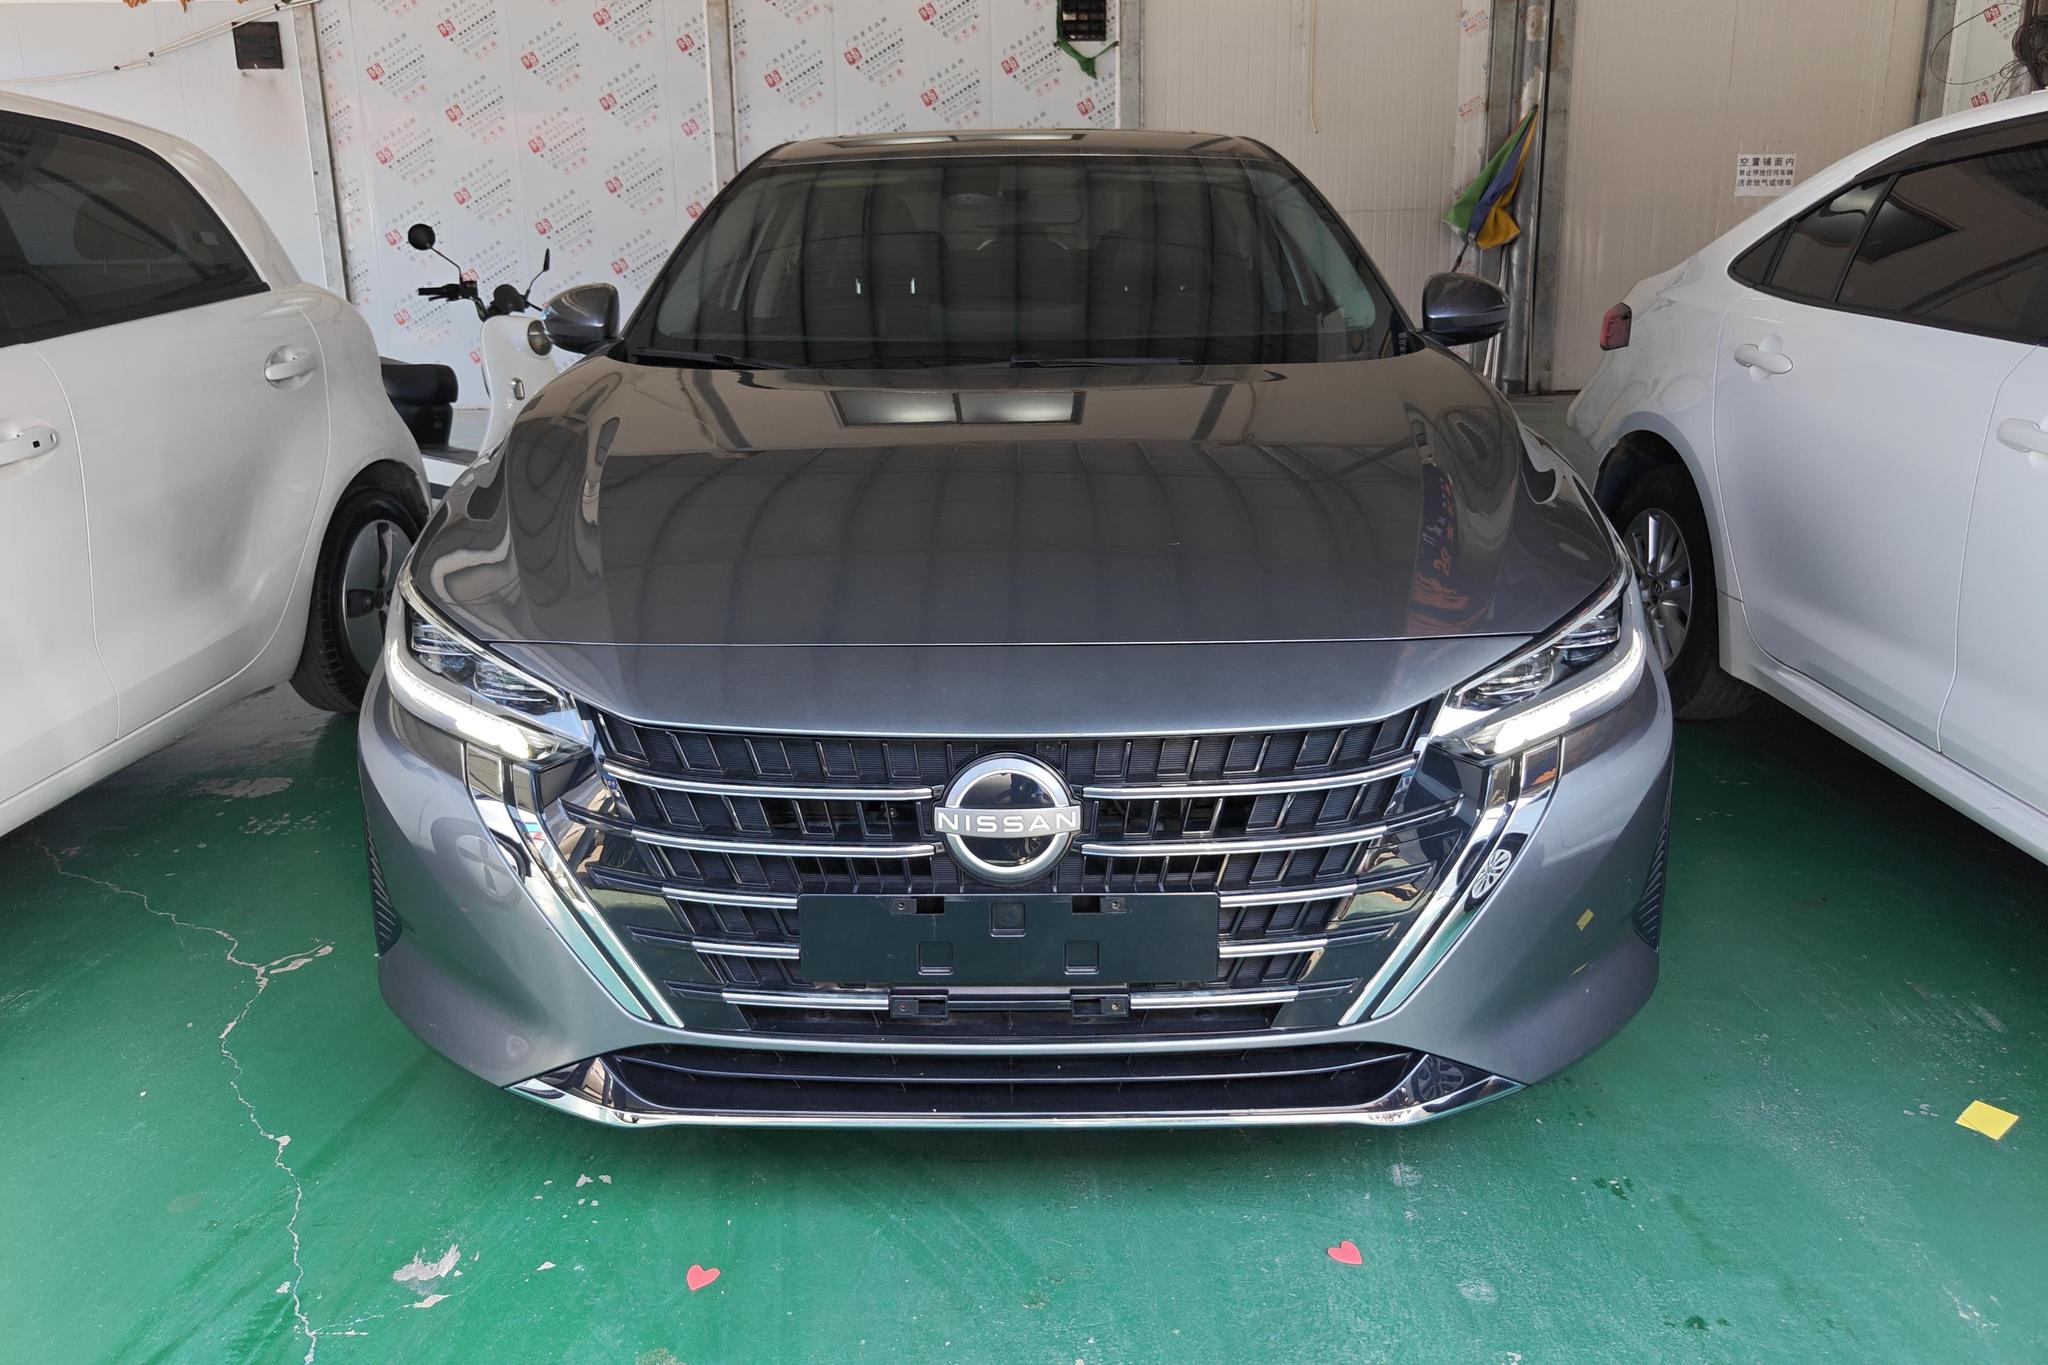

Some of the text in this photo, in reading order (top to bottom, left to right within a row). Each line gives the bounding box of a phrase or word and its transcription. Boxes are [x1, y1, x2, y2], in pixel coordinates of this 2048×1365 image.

[1739, 157, 1795, 167] 空置铺面内
[938, 810, 1077, 833] NISSAN
